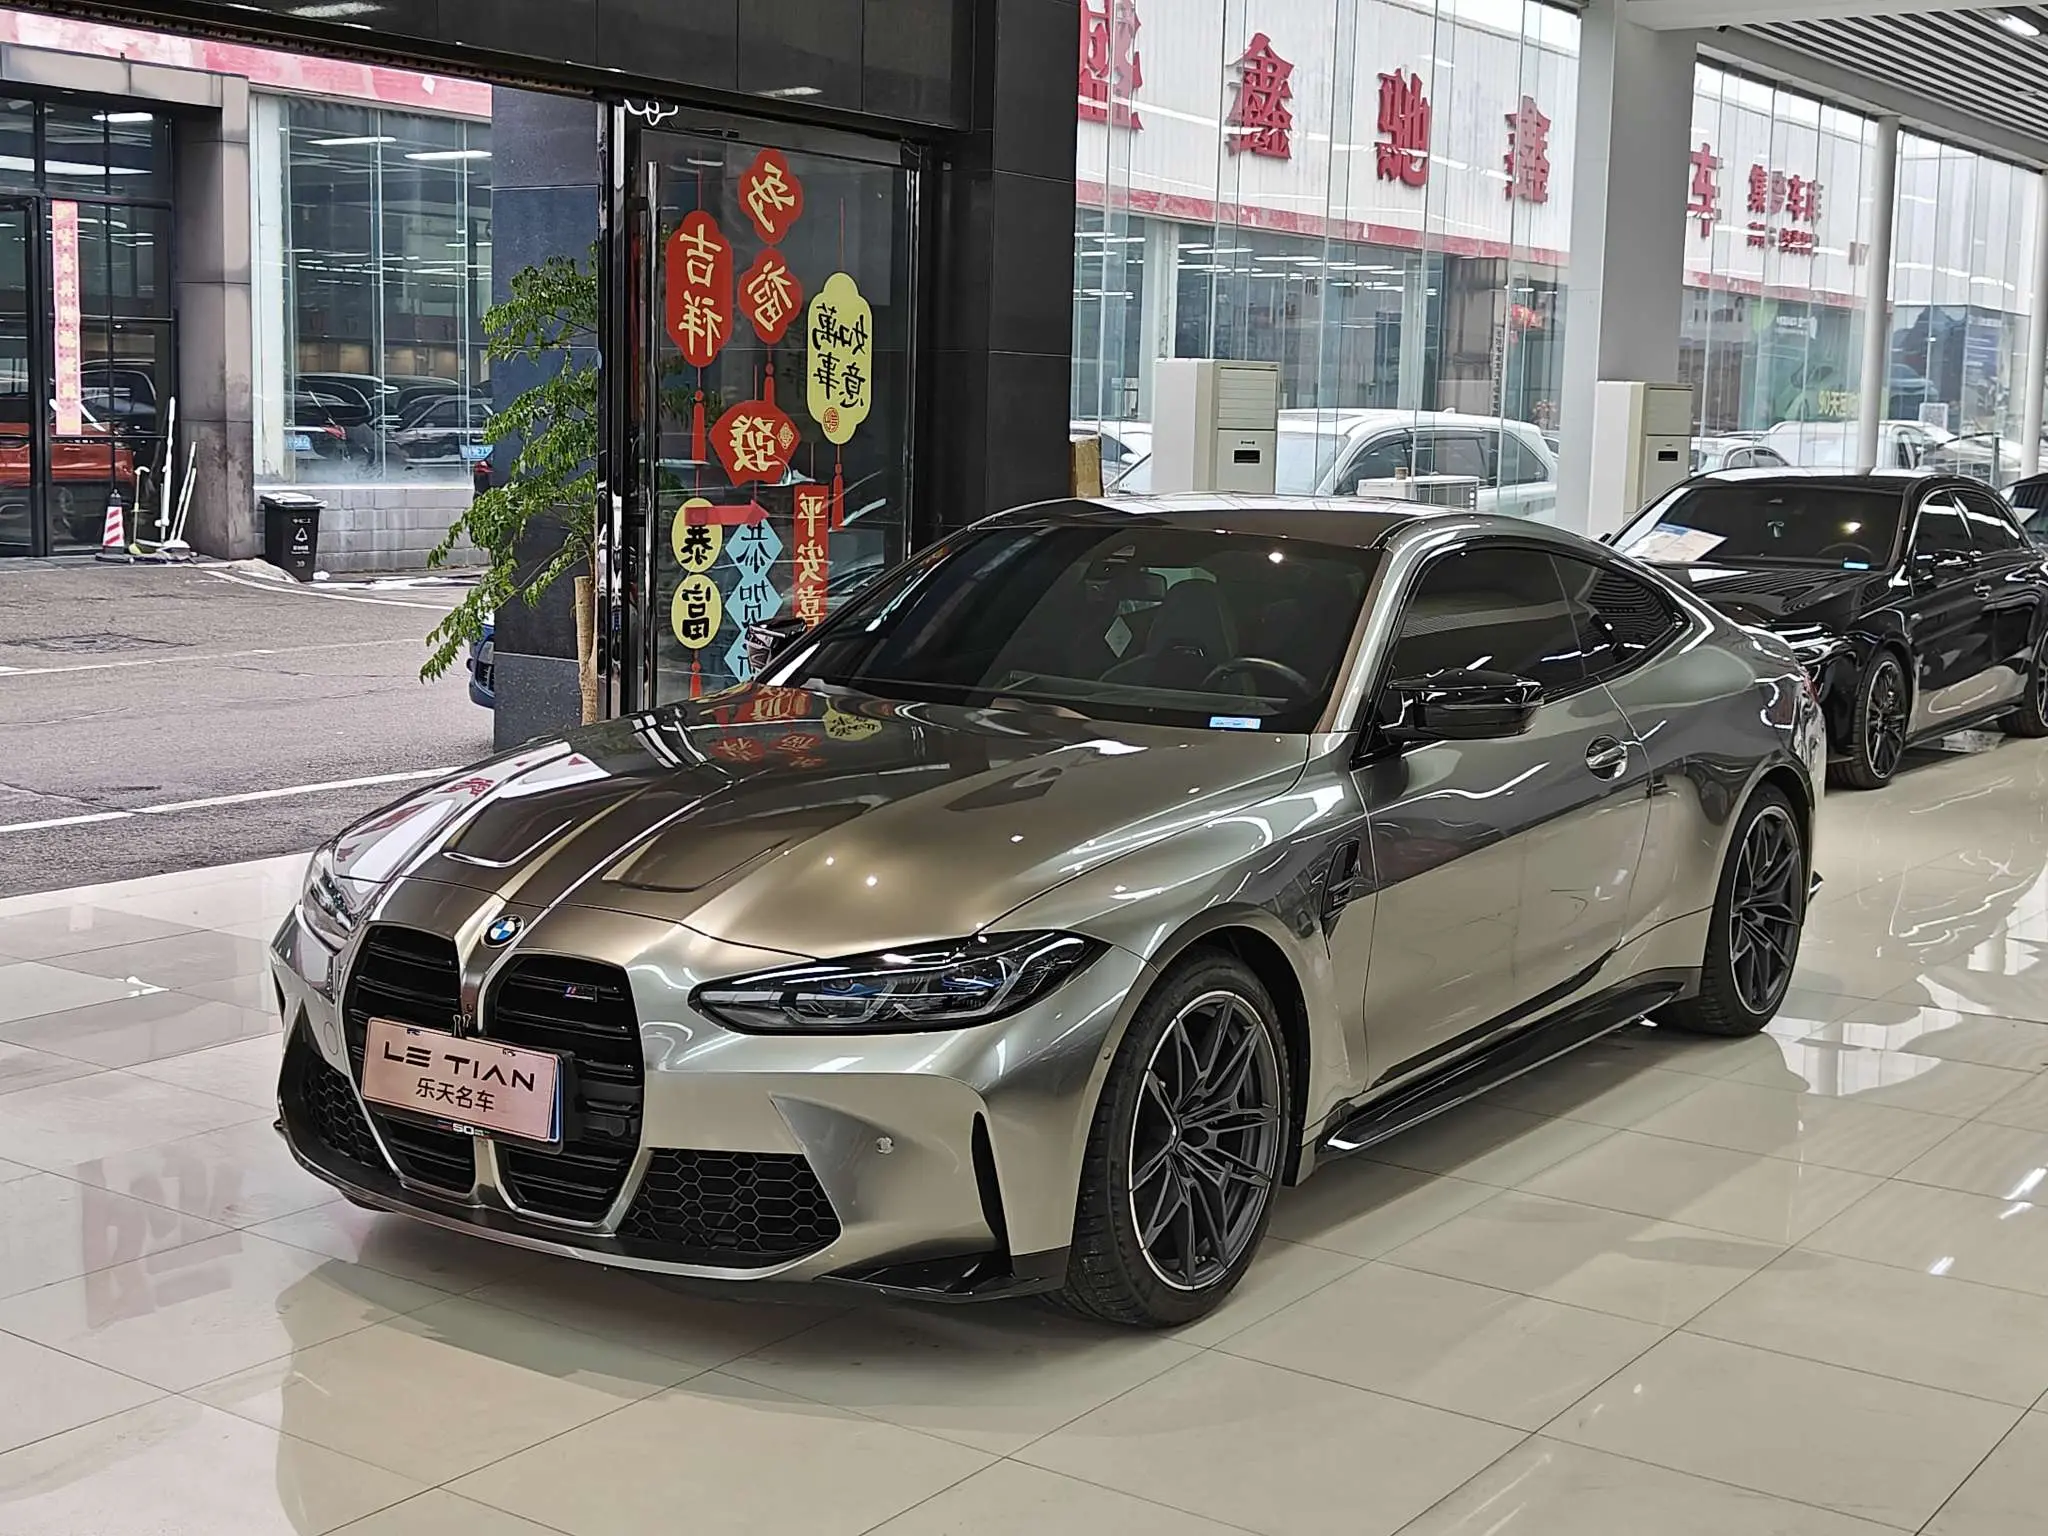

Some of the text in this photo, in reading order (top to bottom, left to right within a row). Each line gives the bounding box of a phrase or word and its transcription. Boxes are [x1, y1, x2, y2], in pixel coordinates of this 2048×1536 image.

[383, 1041, 535, 1092] LE TIAN
[415, 1077, 496, 1113] 乐天名车
